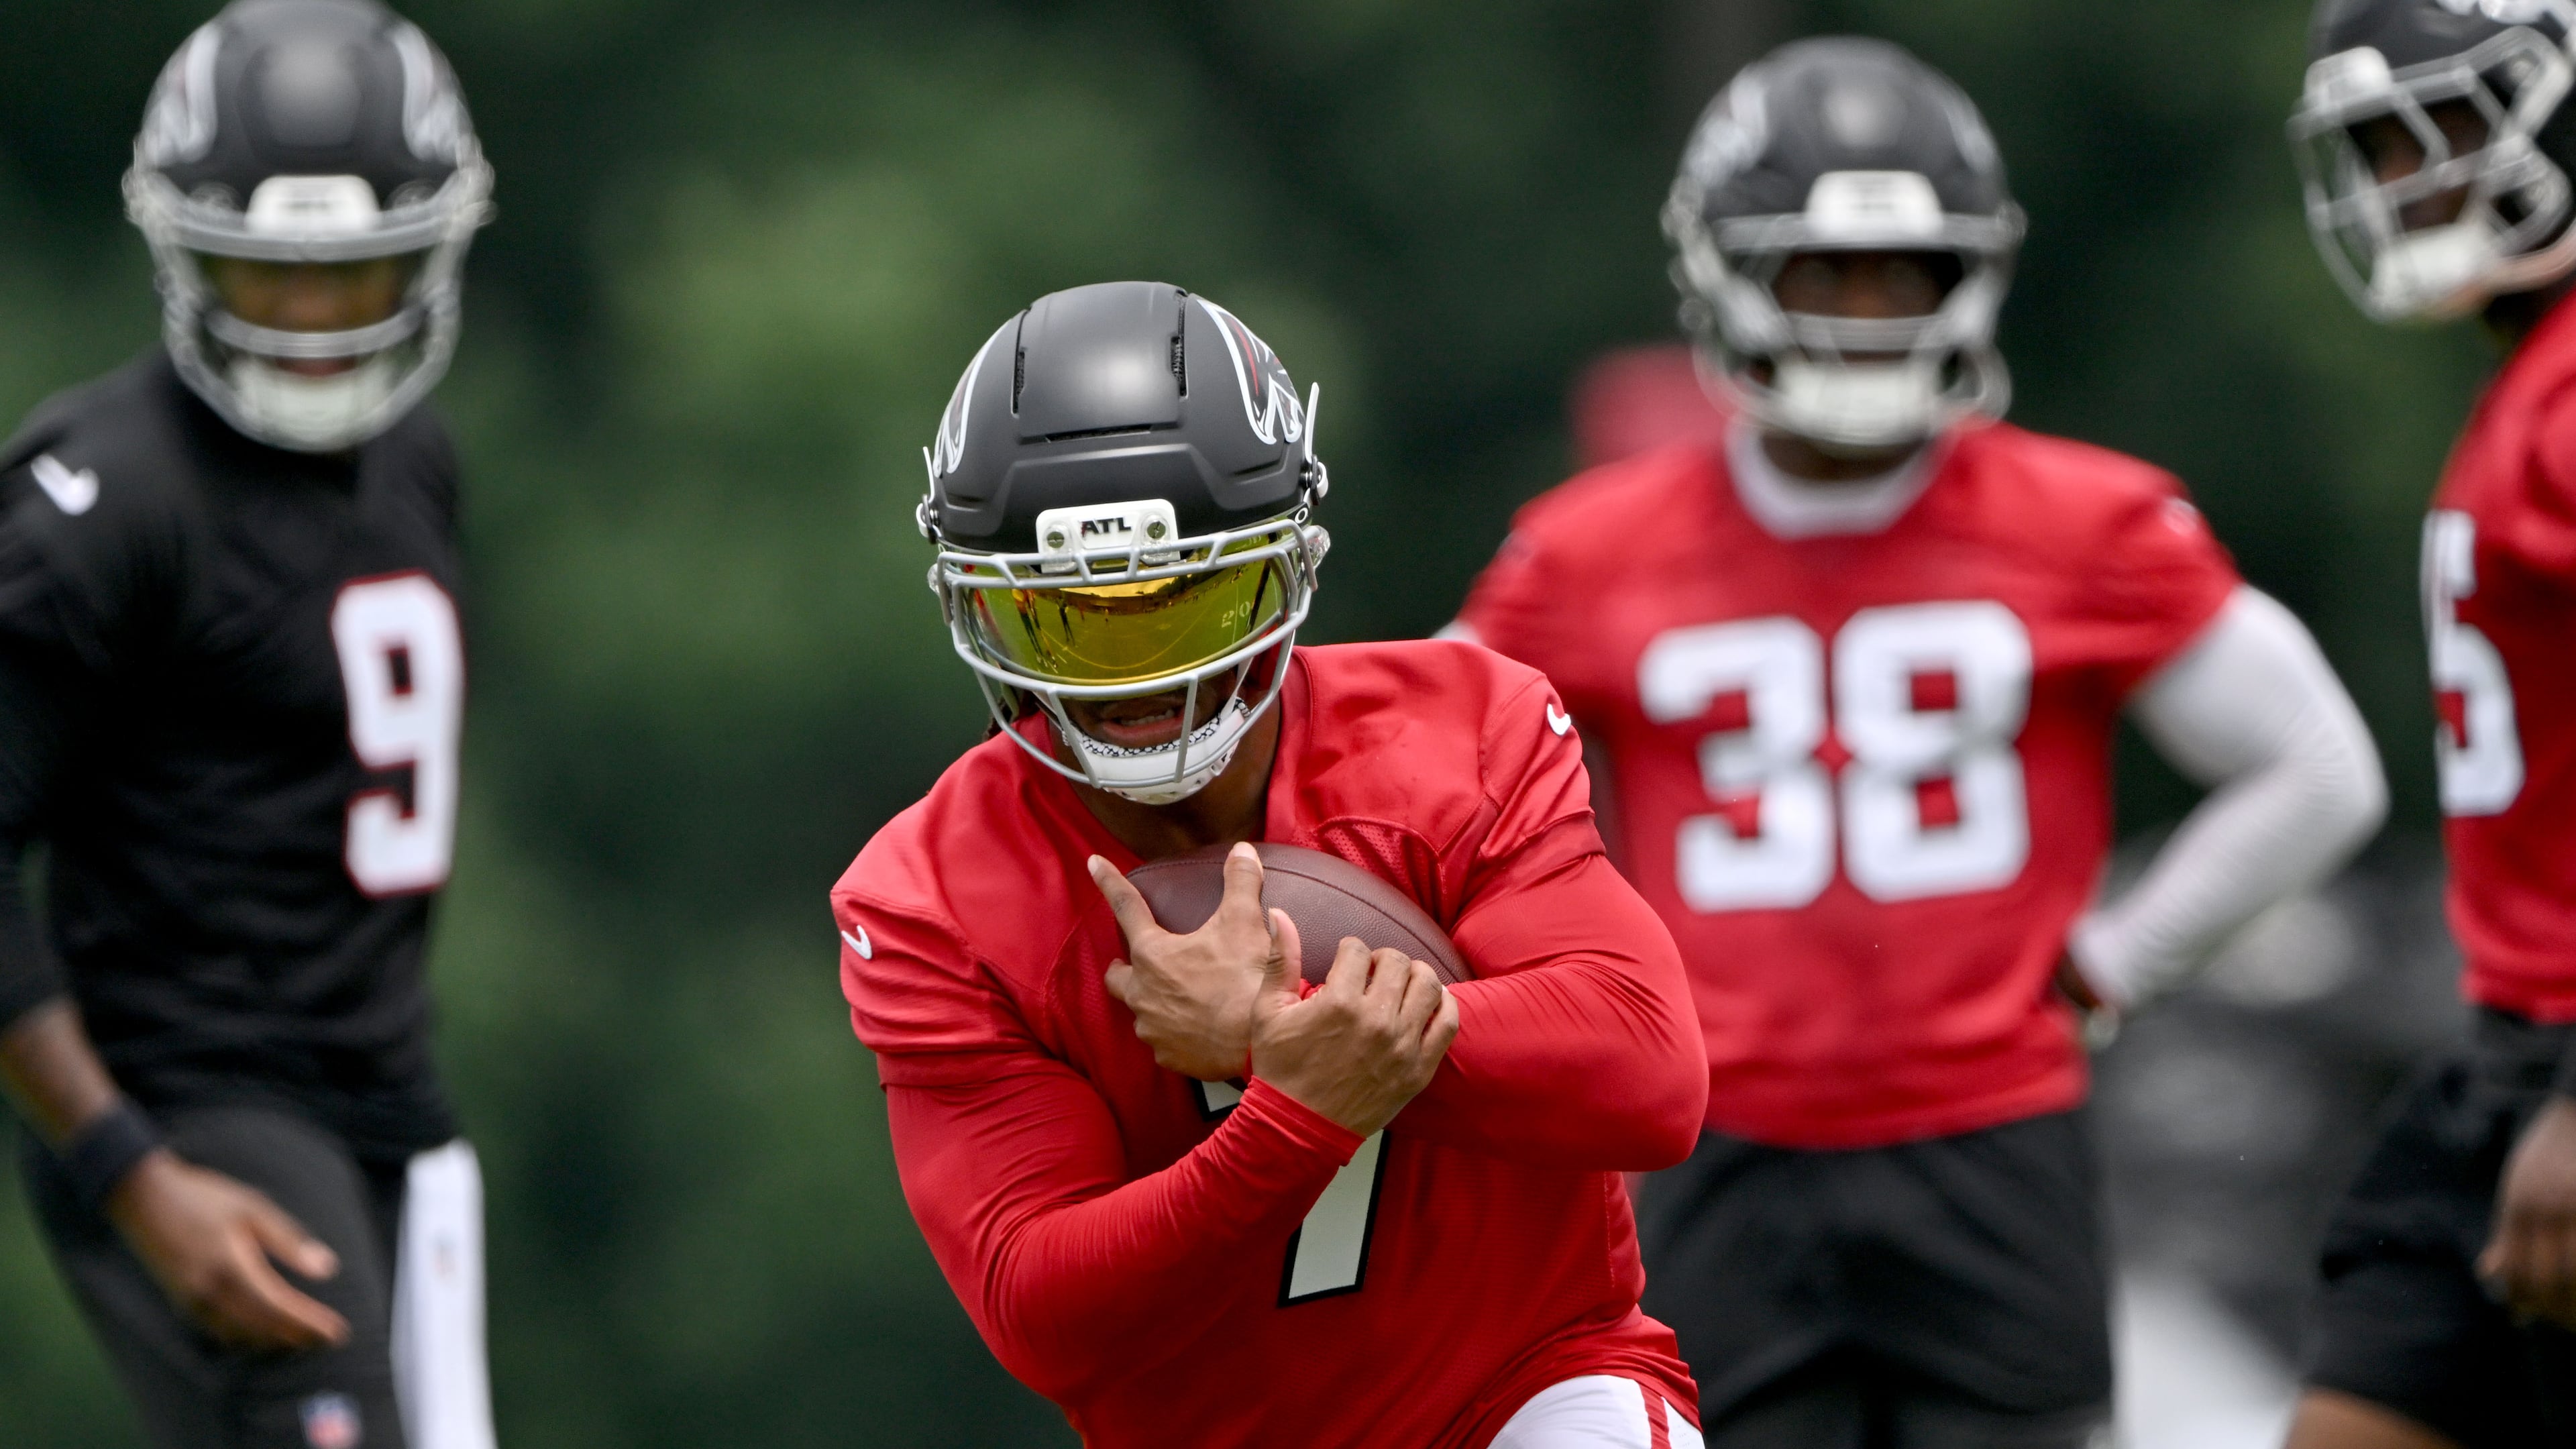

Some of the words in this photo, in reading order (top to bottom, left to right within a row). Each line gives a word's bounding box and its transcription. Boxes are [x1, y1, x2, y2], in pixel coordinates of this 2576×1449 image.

[1081, 517, 1132, 538] ATL
[330, 568, 466, 900] 9
[1637, 598, 2033, 915] 38
